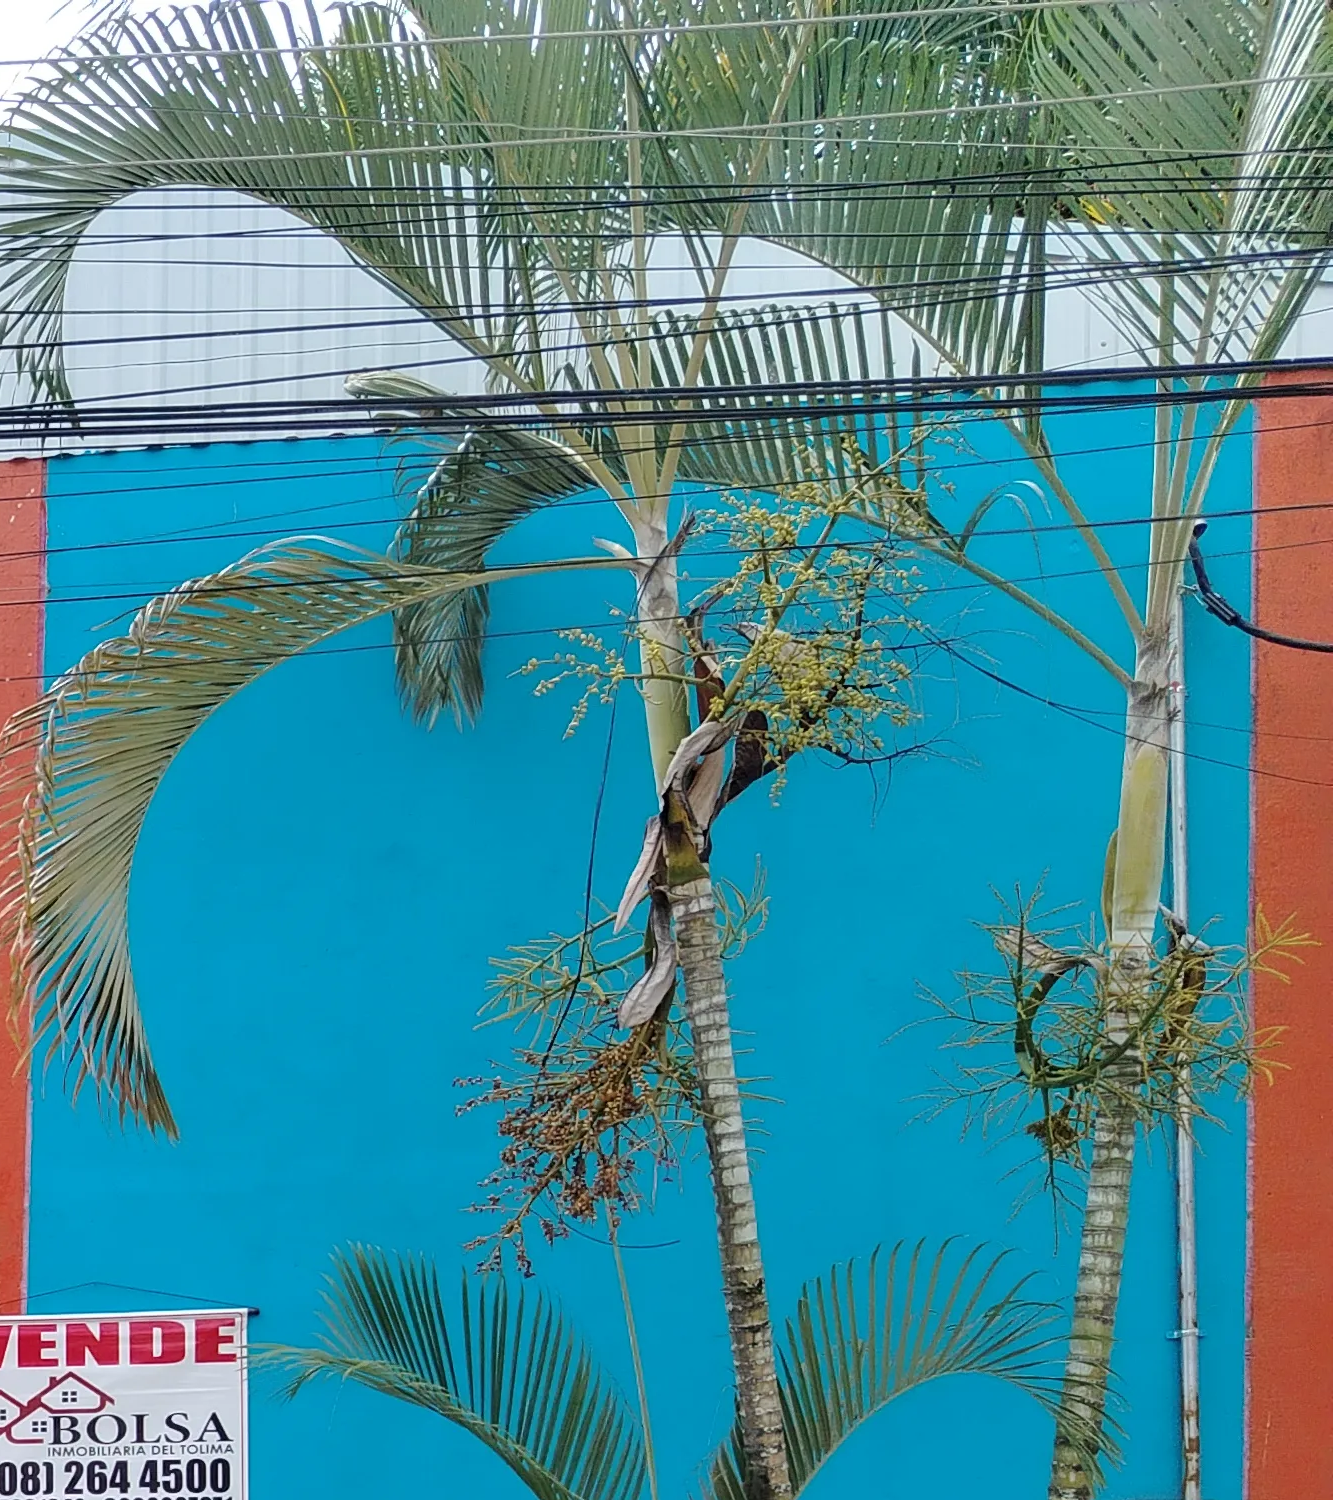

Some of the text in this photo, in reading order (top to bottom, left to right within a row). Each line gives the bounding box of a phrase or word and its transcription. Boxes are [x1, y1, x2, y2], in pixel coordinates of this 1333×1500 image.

[48, 1412, 234, 1445] BOLSA
[47, 1444, 234, 1457] INMOBILIARIA DEL TOLIMA
[64, 1460, 130, 1495] 264
[139, 1458, 231, 1493] 4500
